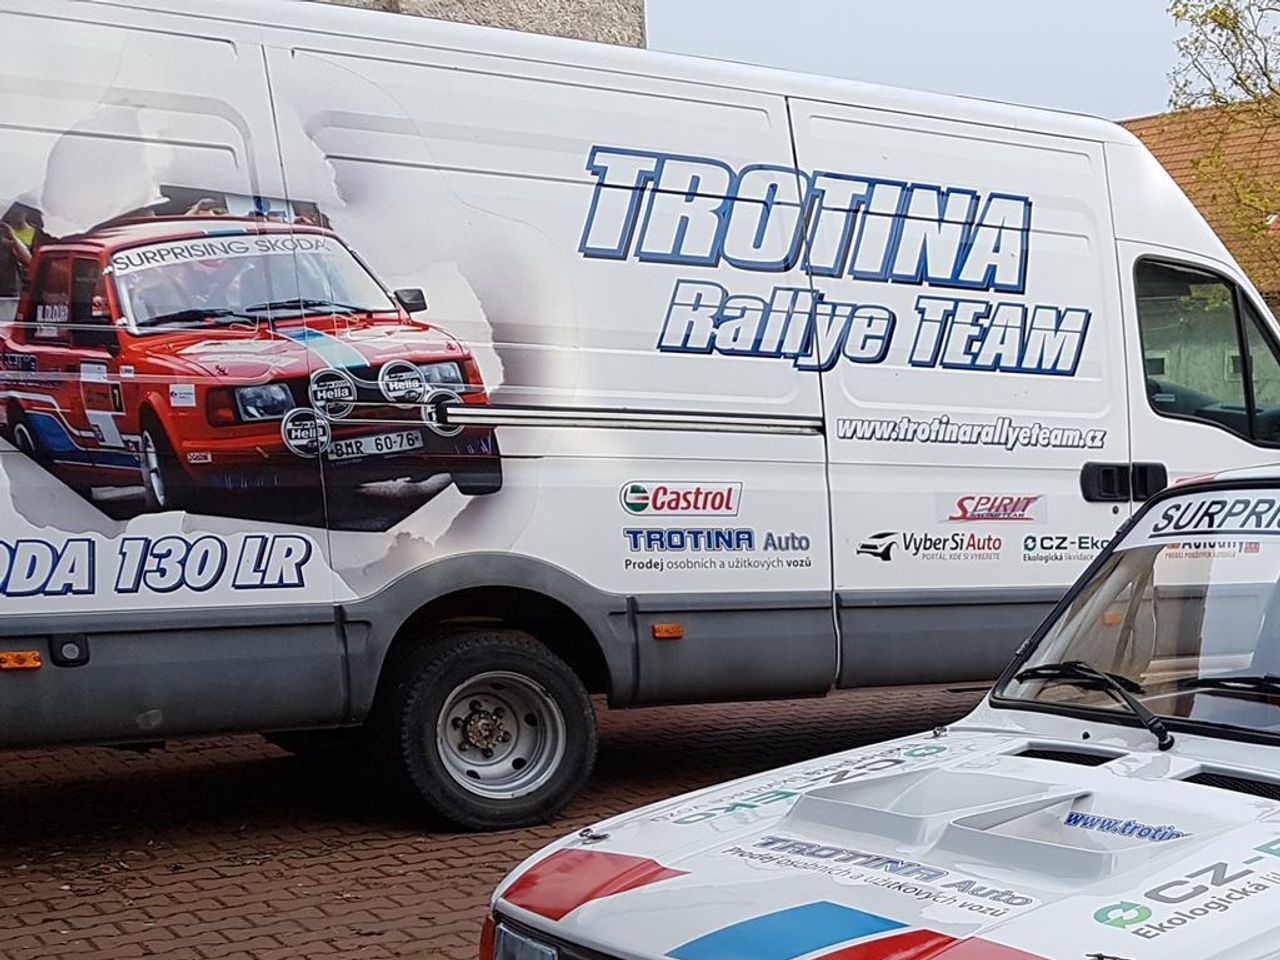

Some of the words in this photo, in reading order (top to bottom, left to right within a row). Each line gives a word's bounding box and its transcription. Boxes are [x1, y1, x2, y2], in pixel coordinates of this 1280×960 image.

[577, 145, 1032, 294] TROTINA
[113, 239, 249, 271] SURPRISING
[254, 237, 329, 252] SKODA
[657, 278, 896, 371] Rallye
[908, 295, 1092, 376] TEAM
[316, 387, 350, 400] Hella
[388, 379, 420, 392] Hella
[291, 426, 324, 440] Hella
[335, 440, 364, 458] BMR
[375, 432, 416, 452] 60-76
[836, 415, 1106, 450] www.trotinarallyeteam.cz
[651, 485, 734, 511] Castrol
[949, 494, 1043, 521] SPIRIT
[624, 527, 756, 552] TROTINA
[763, 532, 811, 551] Auto
[113, 534, 228, 594] 130
[231, 535, 313, 590] LR
[625, 558, 664, 572] Prodej
[666, 557, 717, 570] osobních
[719, 560, 726, 569] a
[728, 557, 784, 571] užitkových
[786, 557, 812, 568] vozů
[1023, 553, 1063, 564] Ekologická
[722, 846, 780, 864] Prodej
[776, 857, 852, 878] osobních
[864, 874, 957, 906] užitkových
[959, 900, 1010, 918] vozů
[753, 834, 950, 884] TROTINA
[941, 879, 1033, 906] Auto
[1131, 881, 1269, 939] Ekologická
